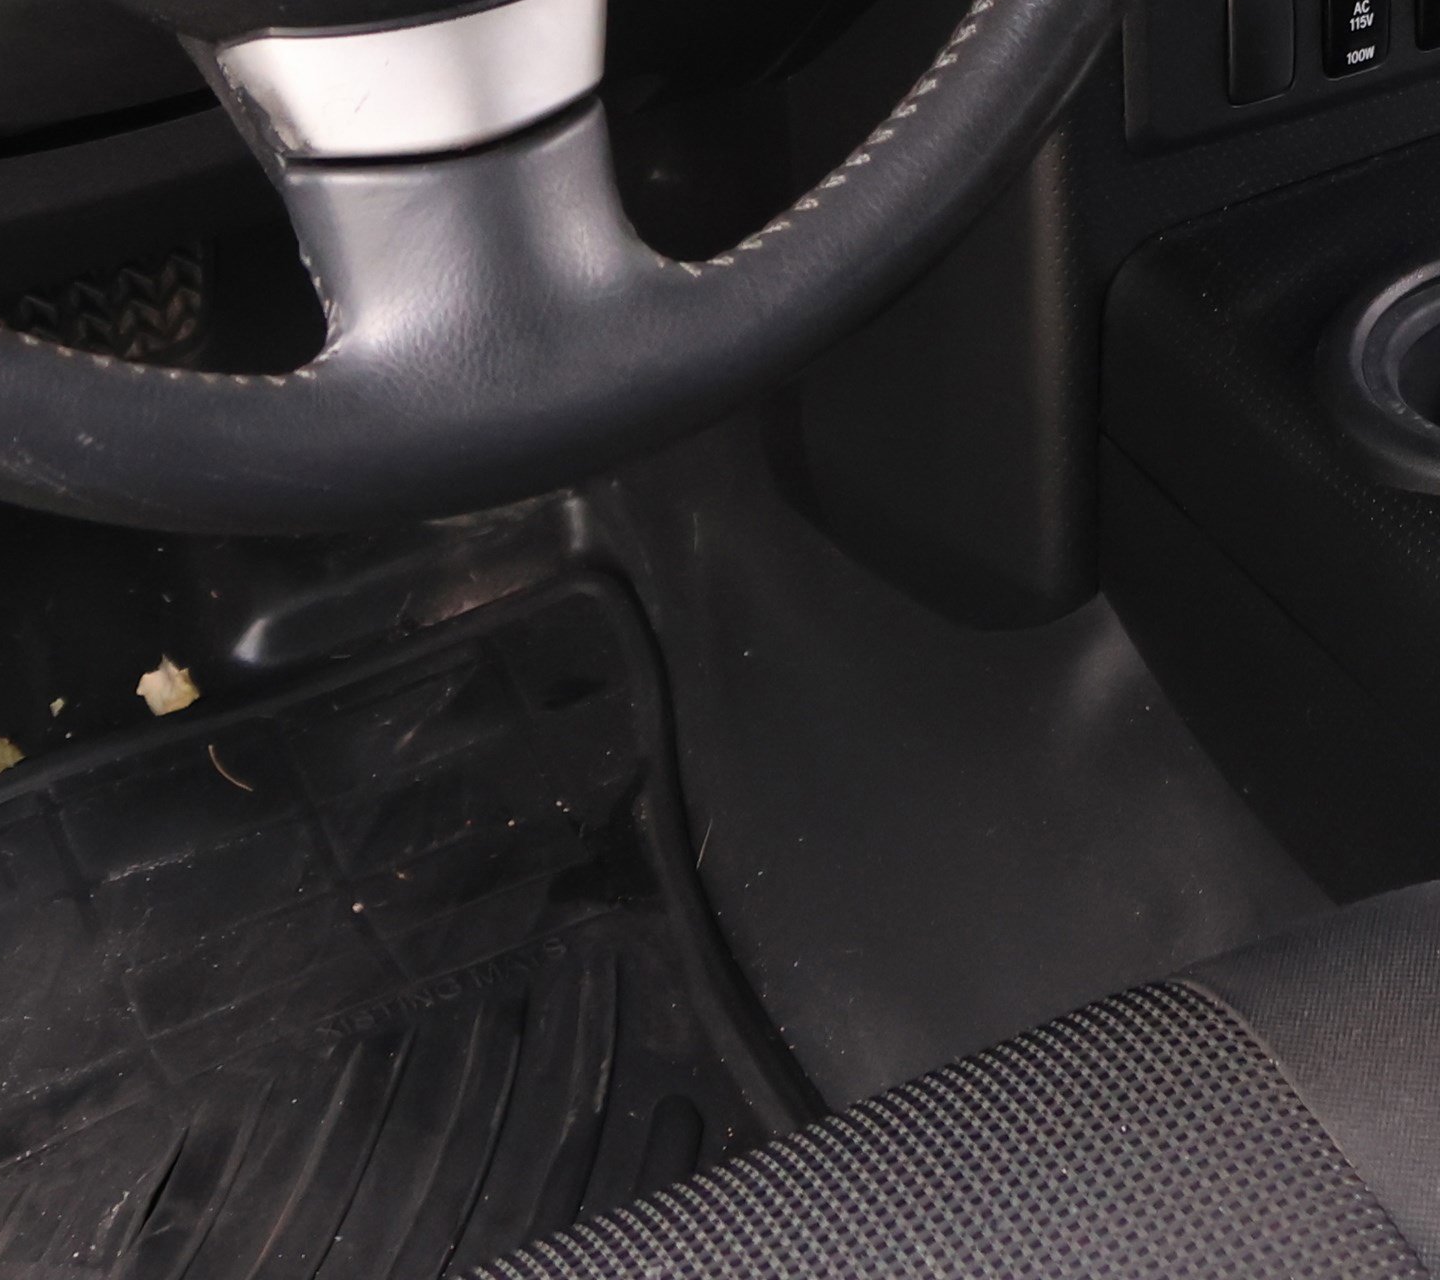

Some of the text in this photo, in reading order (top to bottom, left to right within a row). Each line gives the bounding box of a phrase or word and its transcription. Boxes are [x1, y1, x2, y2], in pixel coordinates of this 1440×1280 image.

[1353, 0, 1371, 16] AC
[1349, 13, 1374, 31] 115V
[1346, 45, 1375, 65] 100W
